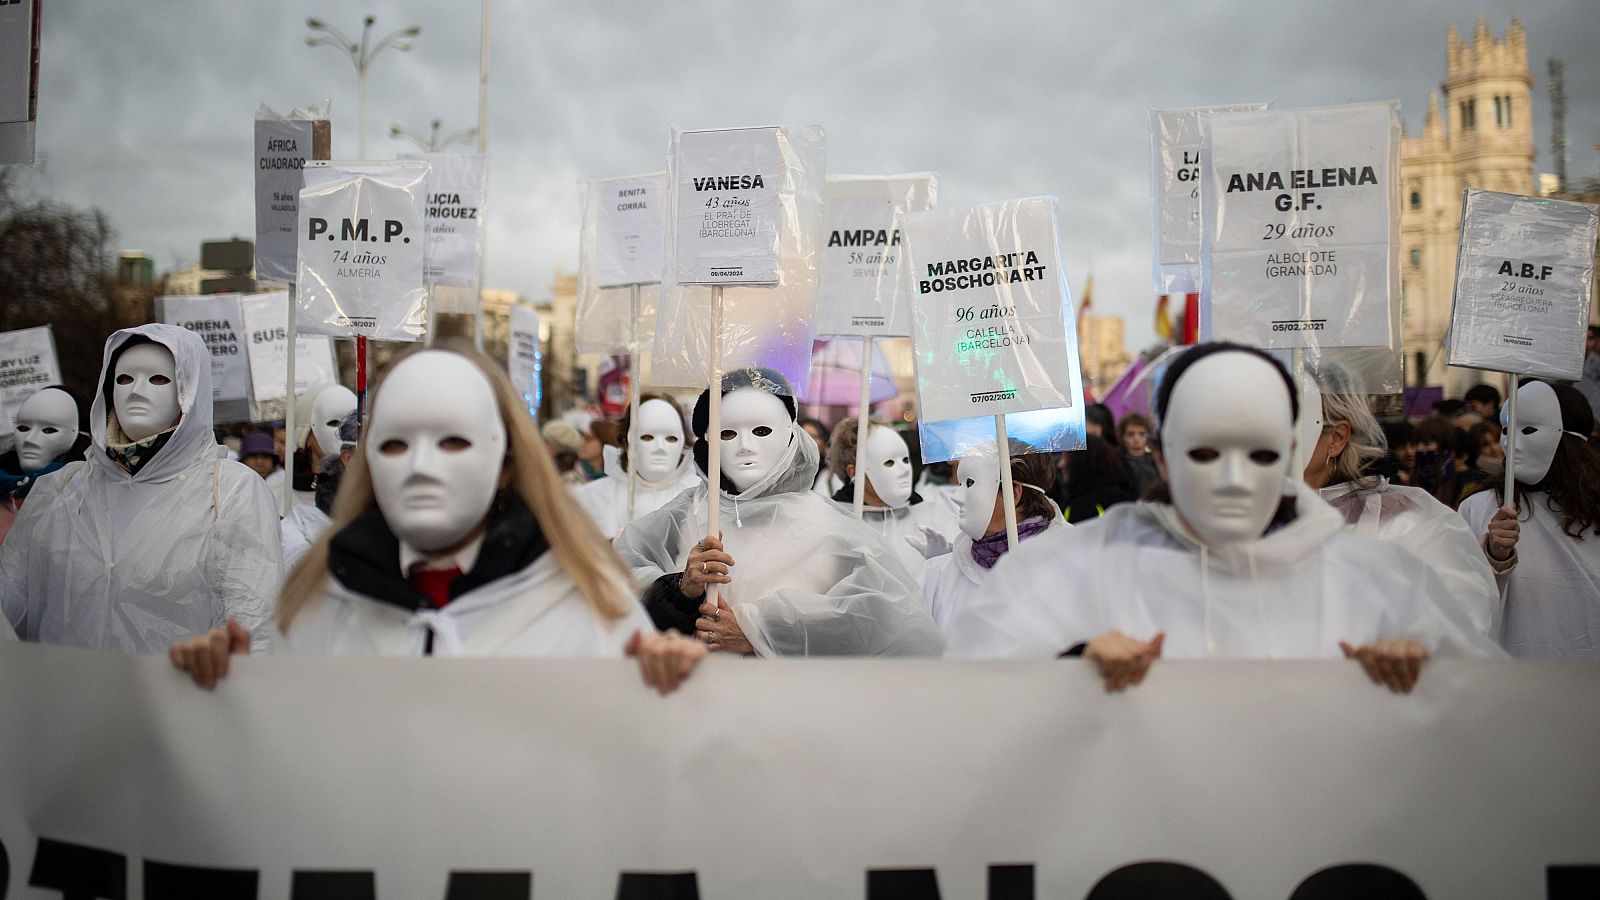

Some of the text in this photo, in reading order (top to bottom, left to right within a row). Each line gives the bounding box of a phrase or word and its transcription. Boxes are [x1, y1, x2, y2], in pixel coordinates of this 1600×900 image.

[267, 136, 298, 152] ÁFRICA
[260, 157, 306, 170] CUADRADO
[693, 174, 764, 191] VANESA
[1227, 166, 1378, 193] ANA ELENA
[618, 188, 646, 198] BENITA
[617, 202, 647, 212] CORRAL
[705, 196, 751, 208] 43 años
[1275, 192, 1322, 212] G.F.
[704, 208, 752, 221] EL PRAT DE
[308, 217, 411, 244] P.M.P.
[702, 219, 751, 229] LLOBREGAT
[699, 228, 756, 238] (BARCELONA)
[1262, 223, 1335, 240] 29 años
[332, 246, 387, 265] 74 años
[848, 252, 895, 264] 58 años
[1267, 251, 1336, 264] ALBOLOTE
[927, 250, 1039, 277] MARGARITA
[1498, 260, 1553, 280] A.B.F
[336, 267, 381, 278] ALMERÍA
[1265, 264, 1338, 279] (GRANADA)
[919, 266, 1046, 294] BOSCHONART
[1501, 281, 1545, 296] 29 años
[1491, 293, 1553, 307] ESPARREGUERA
[956, 303, 1016, 322] 96 años
[966, 325, 1015, 339] CALELLA
[1272, 322, 1324, 332] 05/02/2021
[957, 335, 1030, 353] (BARCELONA)
[971, 392, 1015, 403] 07/02/2021
